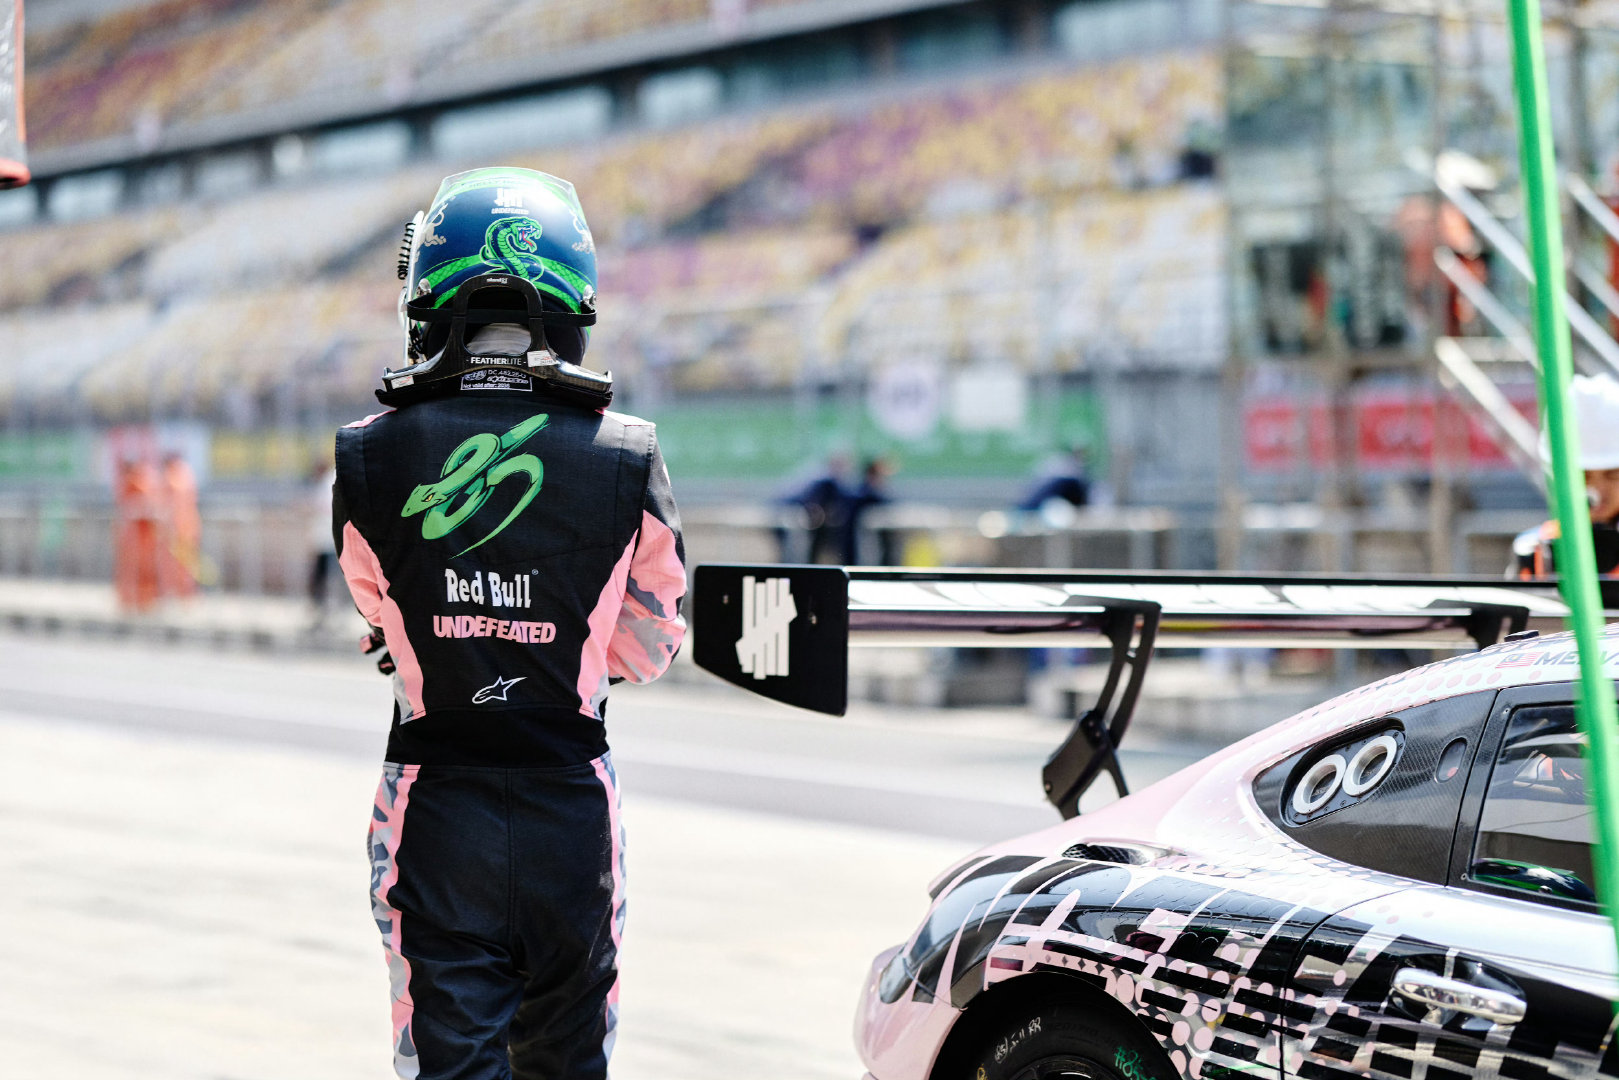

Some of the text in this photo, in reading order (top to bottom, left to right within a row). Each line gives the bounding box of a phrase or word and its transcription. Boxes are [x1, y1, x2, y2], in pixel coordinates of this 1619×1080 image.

[471, 357, 522, 365] FEATHERLITE
[445, 568, 485, 605] Red
[433, 615, 557, 644] UNDEFEATED
